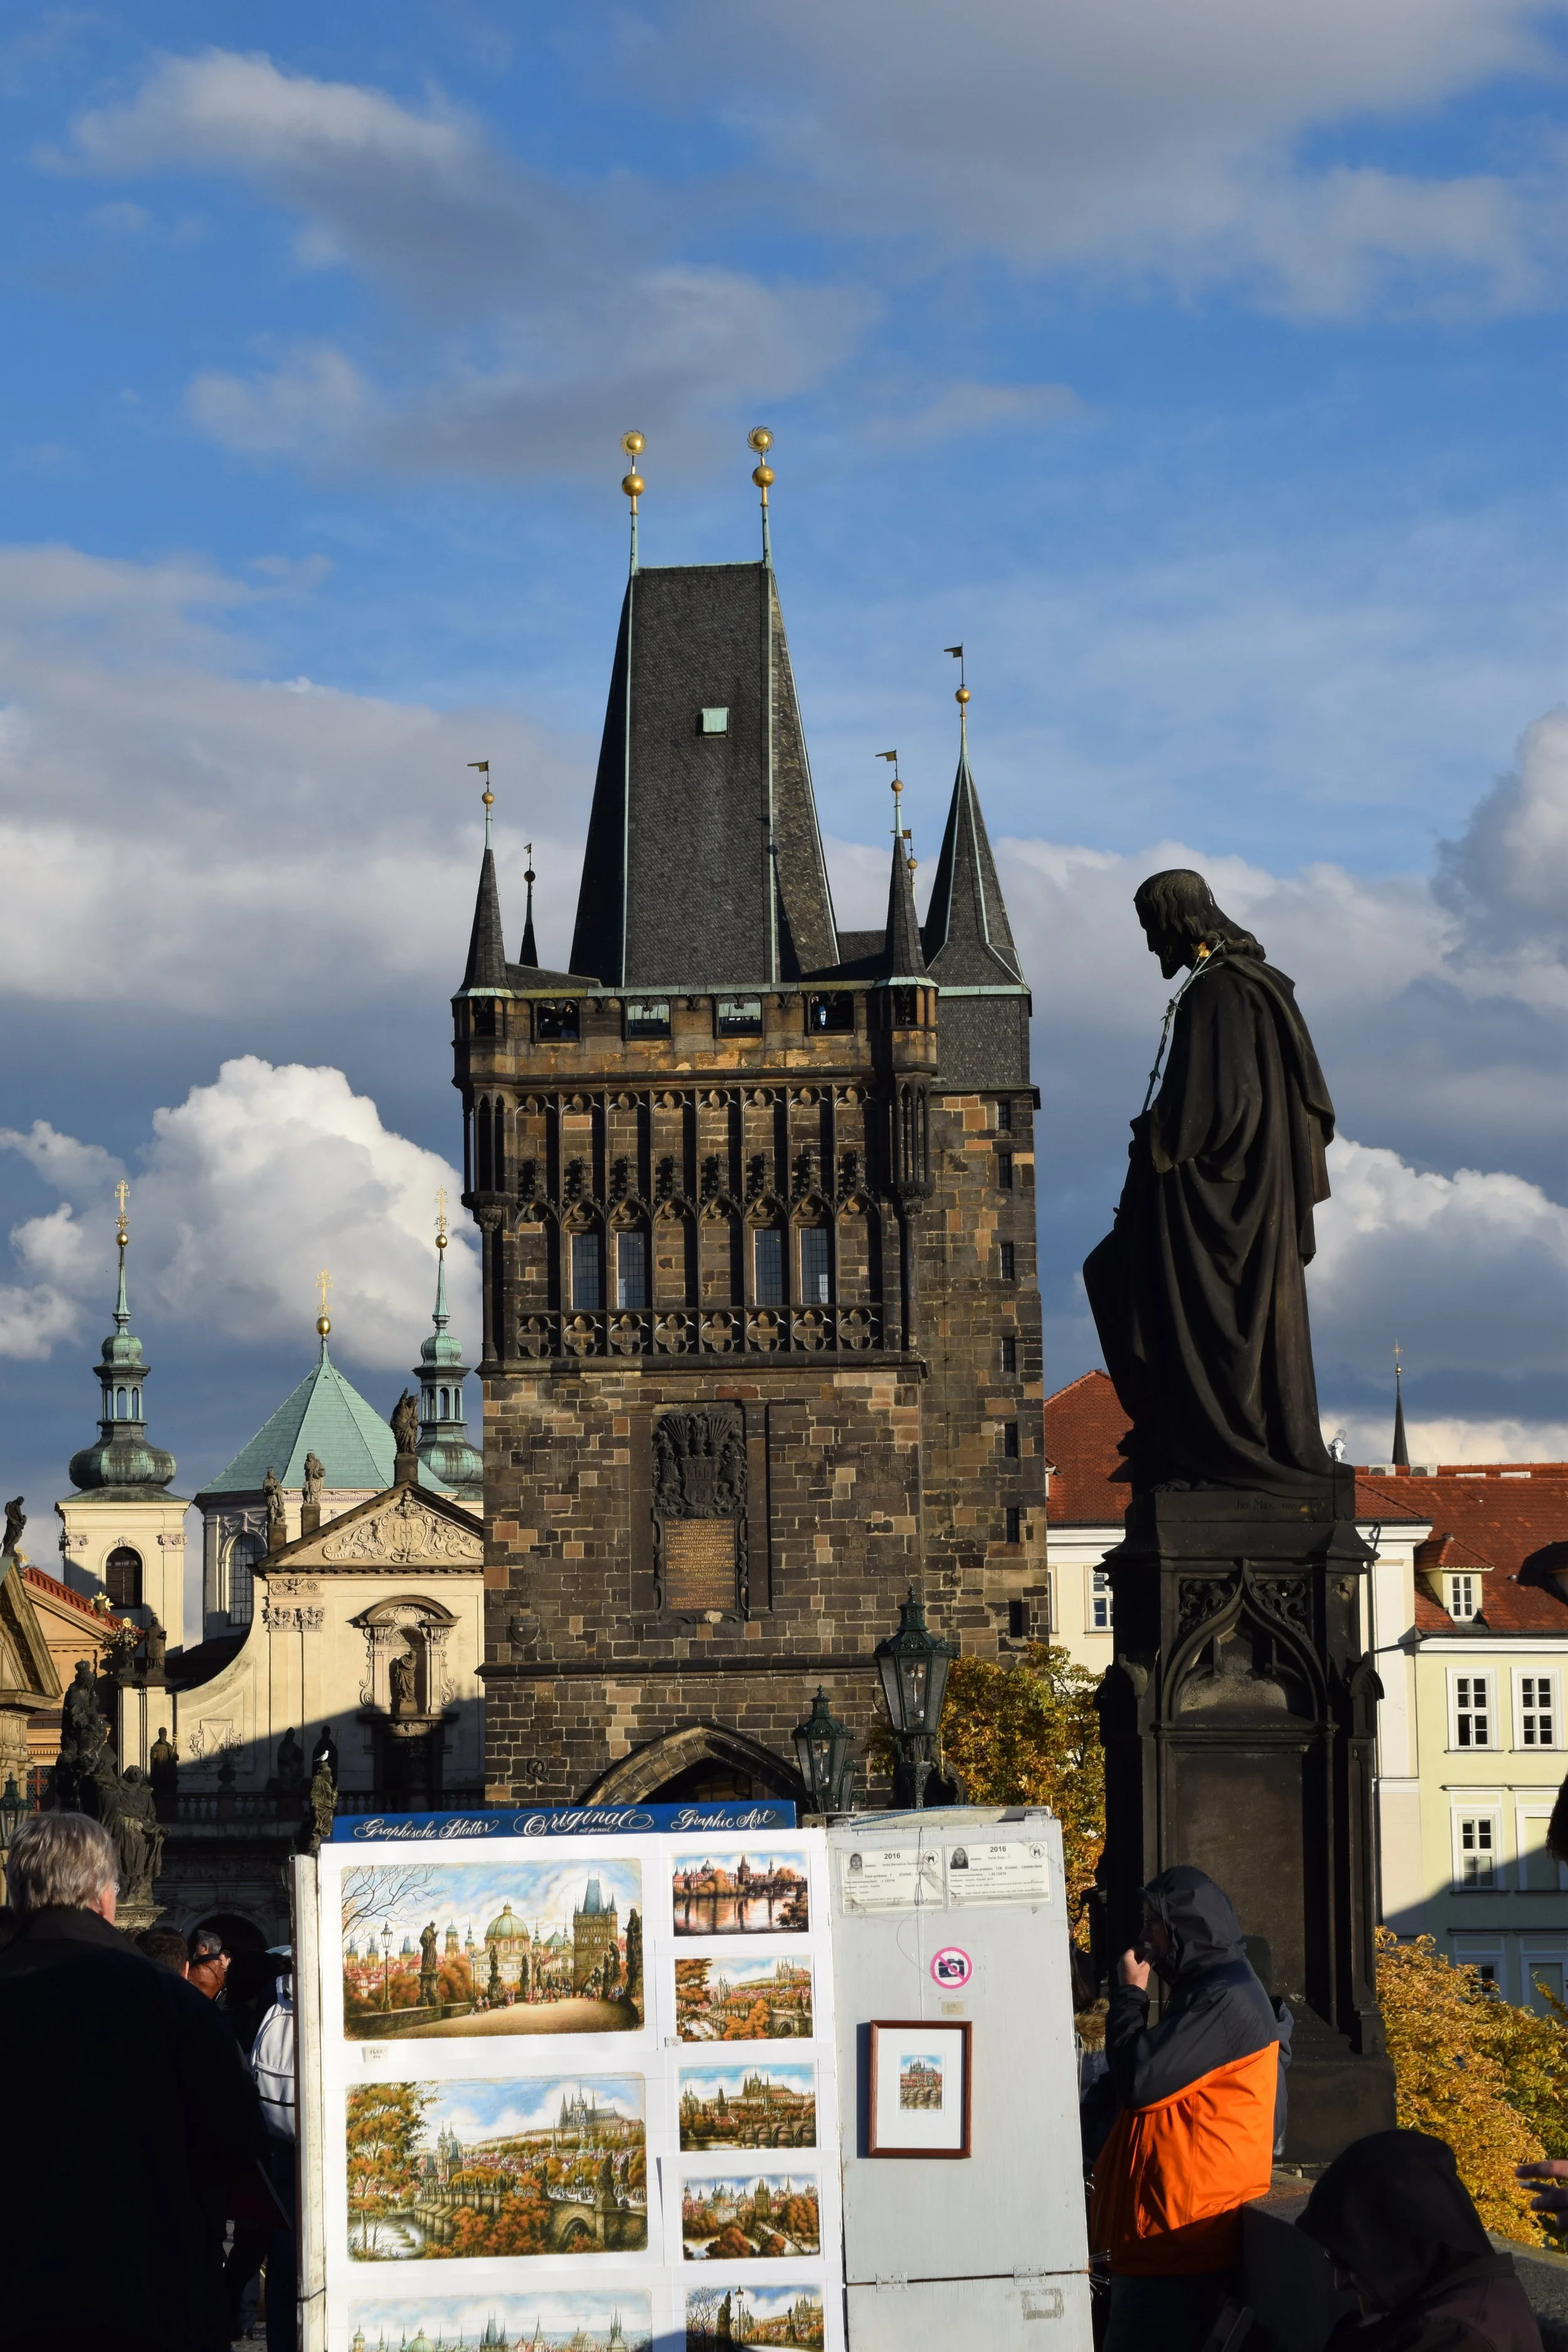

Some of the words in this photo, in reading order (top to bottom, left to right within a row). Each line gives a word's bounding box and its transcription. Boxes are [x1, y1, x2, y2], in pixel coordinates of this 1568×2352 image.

[354, 1818, 437, 1840] Graphische
[439, 1818, 499, 1838] Blätter
[513, 1809, 654, 1836] Original
[670, 1809, 735, 1831] Graphic
[736, 1808, 776, 1830] Art
